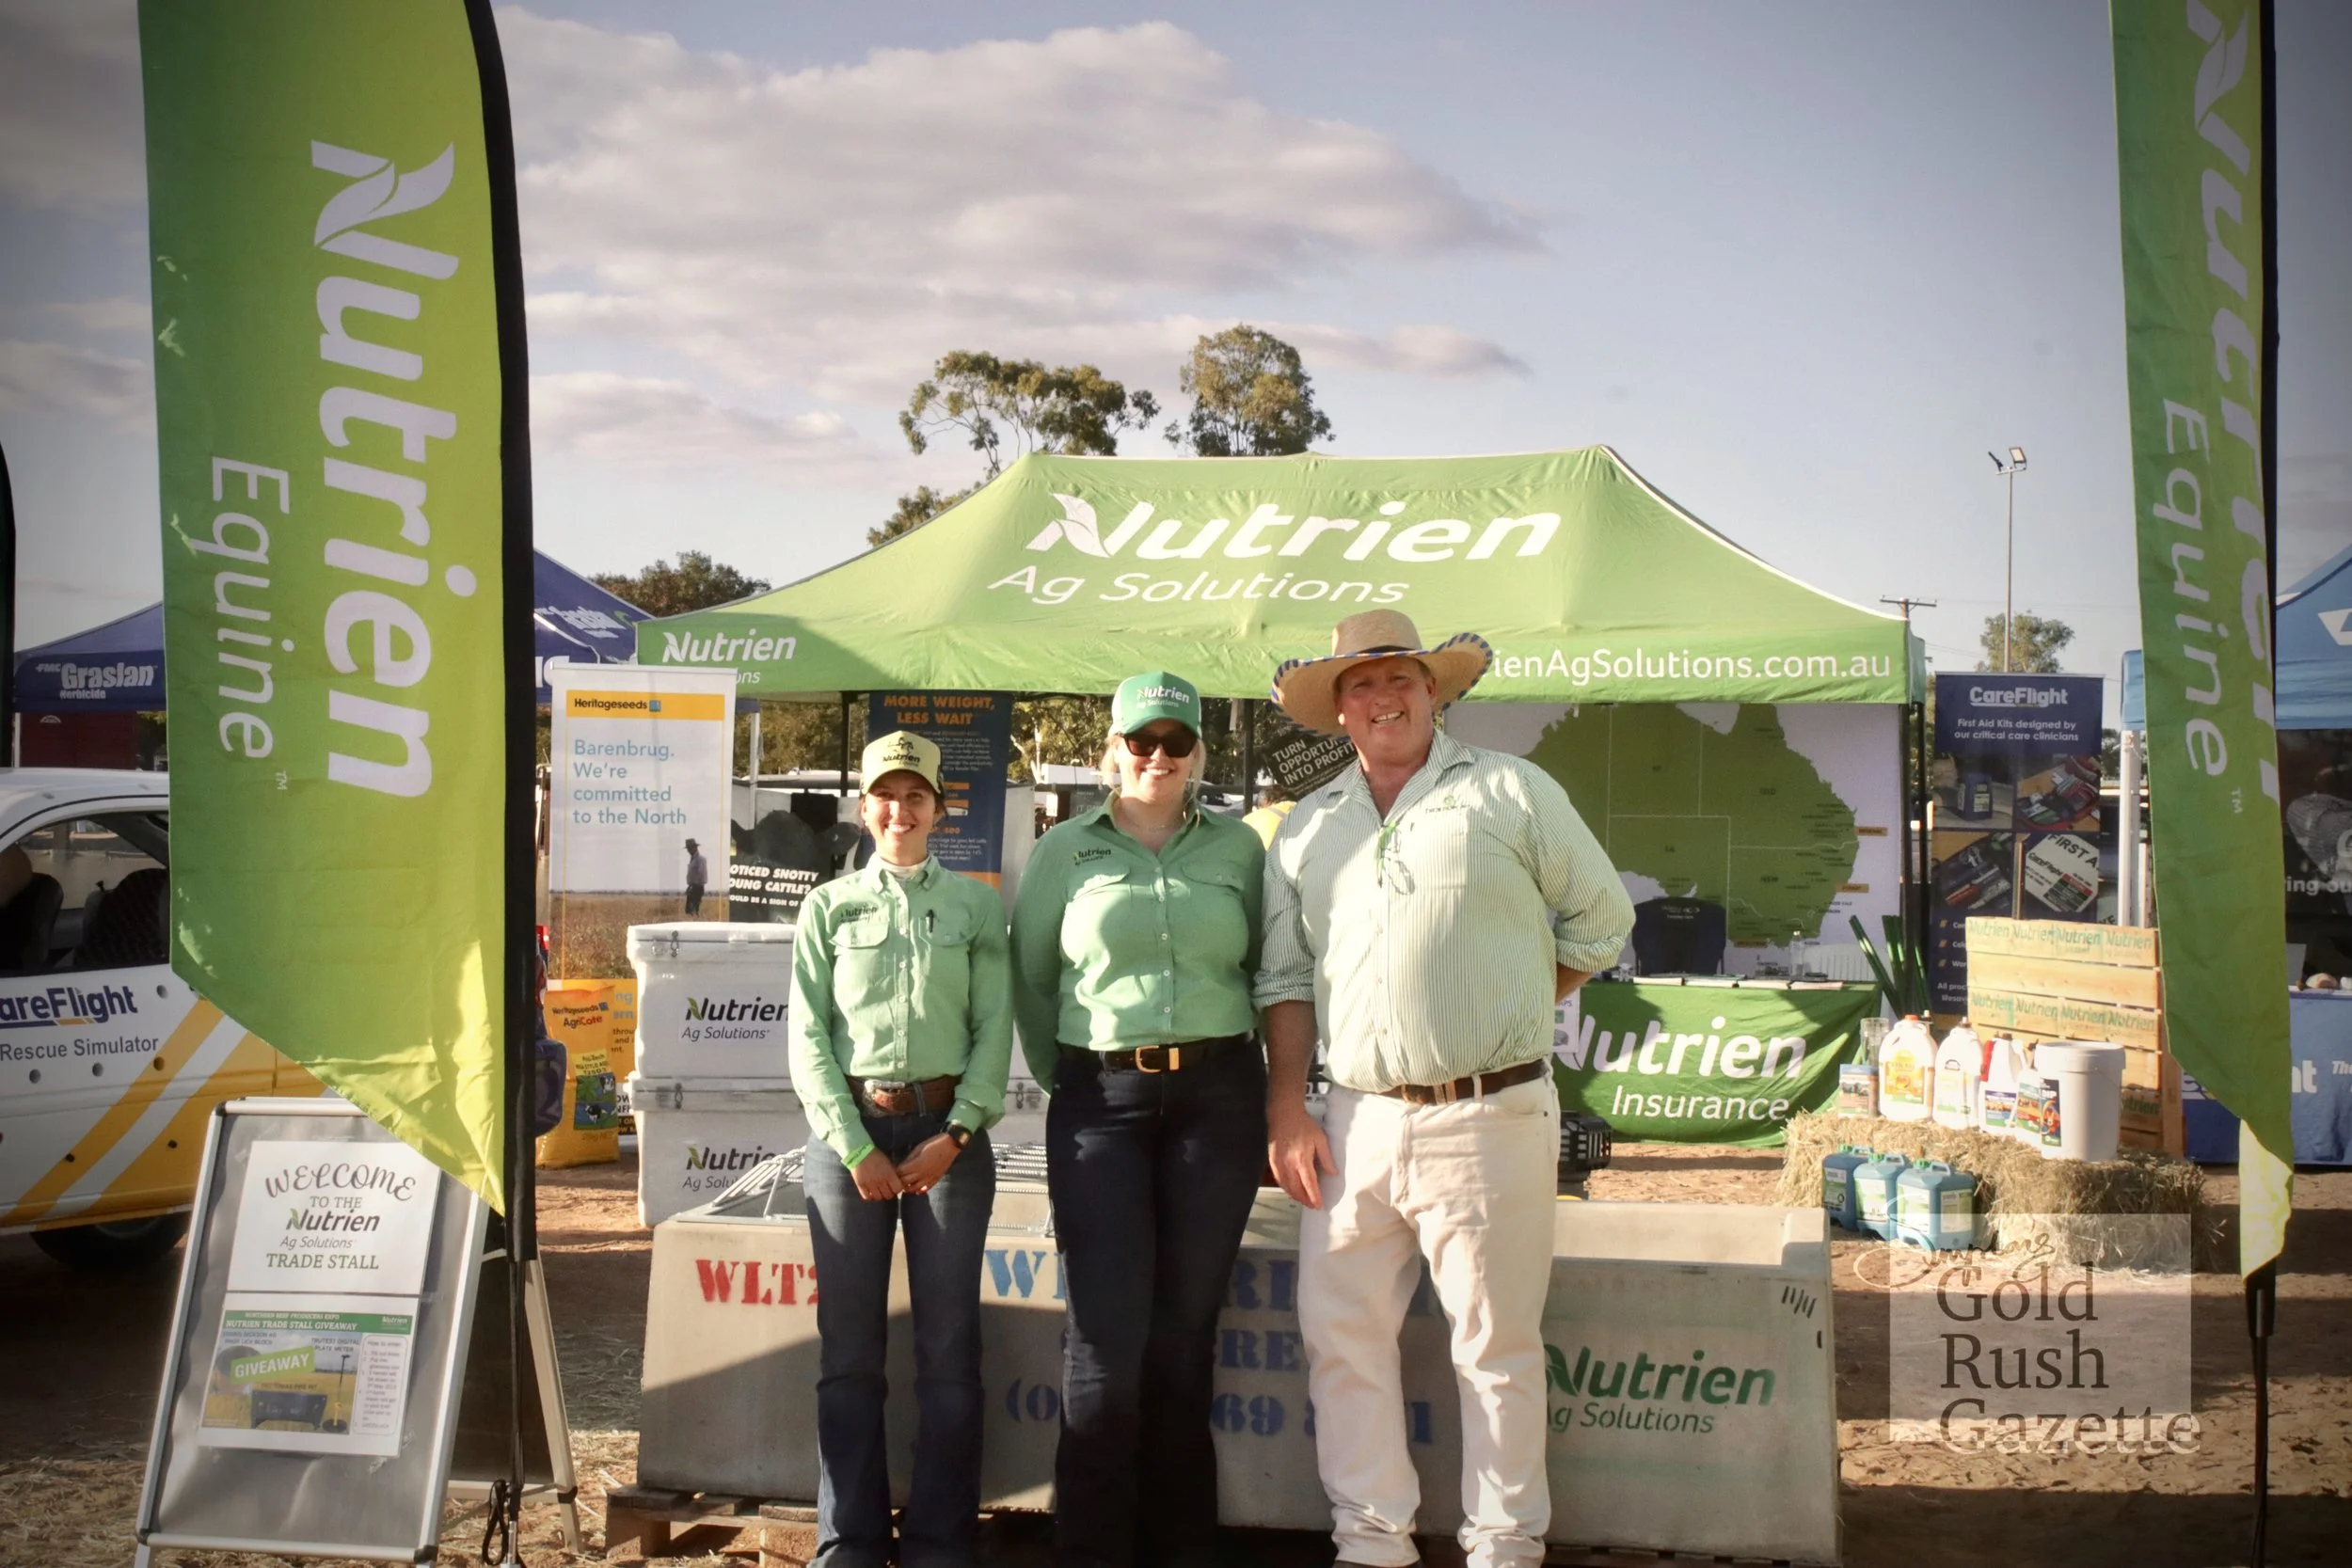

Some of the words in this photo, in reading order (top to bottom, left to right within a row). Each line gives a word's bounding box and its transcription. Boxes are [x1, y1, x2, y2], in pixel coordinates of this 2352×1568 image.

[310, 139, 477, 798] Nutrien
[1025, 492, 1562, 562] Nutrien
[988, 565, 1086, 605] Ag
[1099, 571, 1410, 604] Solutions
[2153, 398, 2229, 777] Equine
[192, 456, 294, 758] Equine
[661, 628, 796, 663] Nutrien
[60, 662, 154, 689] Graslan
[1486, 648, 1891, 686] ienAgSolutions.com.au
[59, 689, 106, 699] Herbicide
[574, 698, 648, 711] Heritageseeds
[883, 695, 928, 708] MORE
[1136, 685, 1190, 704] Nutrien
[1147, 699, 1180, 708] Solutions
[1969, 687, 2068, 707] CareFlight
[897, 712, 930, 724] LESS
[934, 712, 973, 724] WAIT
[1957, 719, 1976, 728] First
[1978, 720, 1994, 728] Aid
[1996, 720, 2013, 728] Kits
[2015, 720, 2061, 730] designed
[2063, 721, 2076, 731] by
[1972, 731, 2006, 739] critical
[2032, 732, 2079, 741] clinicians
[573, 739, 675, 761] Barenbrug.
[882, 752, 921, 764] Nutrien
[1272, 738, 1307, 763] TURN
[1279, 737, 1339, 773] OPPORTU
[573, 763, 628, 779] We're
[1283, 764, 1314, 785] INTO
[1314, 741, 1356, 769] PROFIT
[573, 786, 672, 802] committed
[573, 810, 592, 824] to
[597, 809, 628, 824] the
[634, 809, 688, 825] North
[2046, 832, 2090, 859] FIRST
[729, 864, 771, 878] OTICED
[772, 868, 819, 882] SNOTTY
[729, 878, 762, 891] OUNG
[765, 881, 812, 895] CATTLE?
[1968, 920, 2010, 938] Nutrien
[2012, 924, 2056, 942] Nutrien
[2057, 927, 2102, 945] Nutrien
[2107, 929, 2153, 949] Nutrien
[0, 986, 138, 1023] areFlight
[2015, 994, 2058, 1018] Nutrien
[2059, 1003, 2106, 1025] Nutrien
[2107, 1009, 2155, 1032] Nutrien
[612, 1027, 633, 1036] throu
[681, 1026, 699, 1041] Ag
[703, 1027, 765, 1039] Solutions
[0, 1042, 67, 1061] Rescue
[73, 1037, 159, 1056] Simulator
[1612, 1085, 1789, 1120] Insurance
[686, 1146, 777, 1170] Nutri
[265, 1163, 417, 1201] WELCOME
[682, 1177, 700, 1191] Ag
[310, 1196, 329, 1208] TO
[334, 1196, 363, 1209] THE
[286, 1208, 381, 1232] Nutrien
[279, 1236, 296, 1249] Ag
[300, 1236, 354, 1249] Solutions
[266, 1253, 324, 1268] TRADE
[327, 1255, 379, 1270] STALL
[226, 1320, 261, 1328] NUTRIEN
[289, 1321, 313, 1329] STALL
[314, 1322, 358, 1331] GIVEAWAY
[381, 1316, 408, 1324] Nutrien
[235, 1353, 310, 1378] GIVEAWAY
[1544, 1343, 1775, 1406] Nutrien
[1580, 1402, 1715, 1433] Solutions
